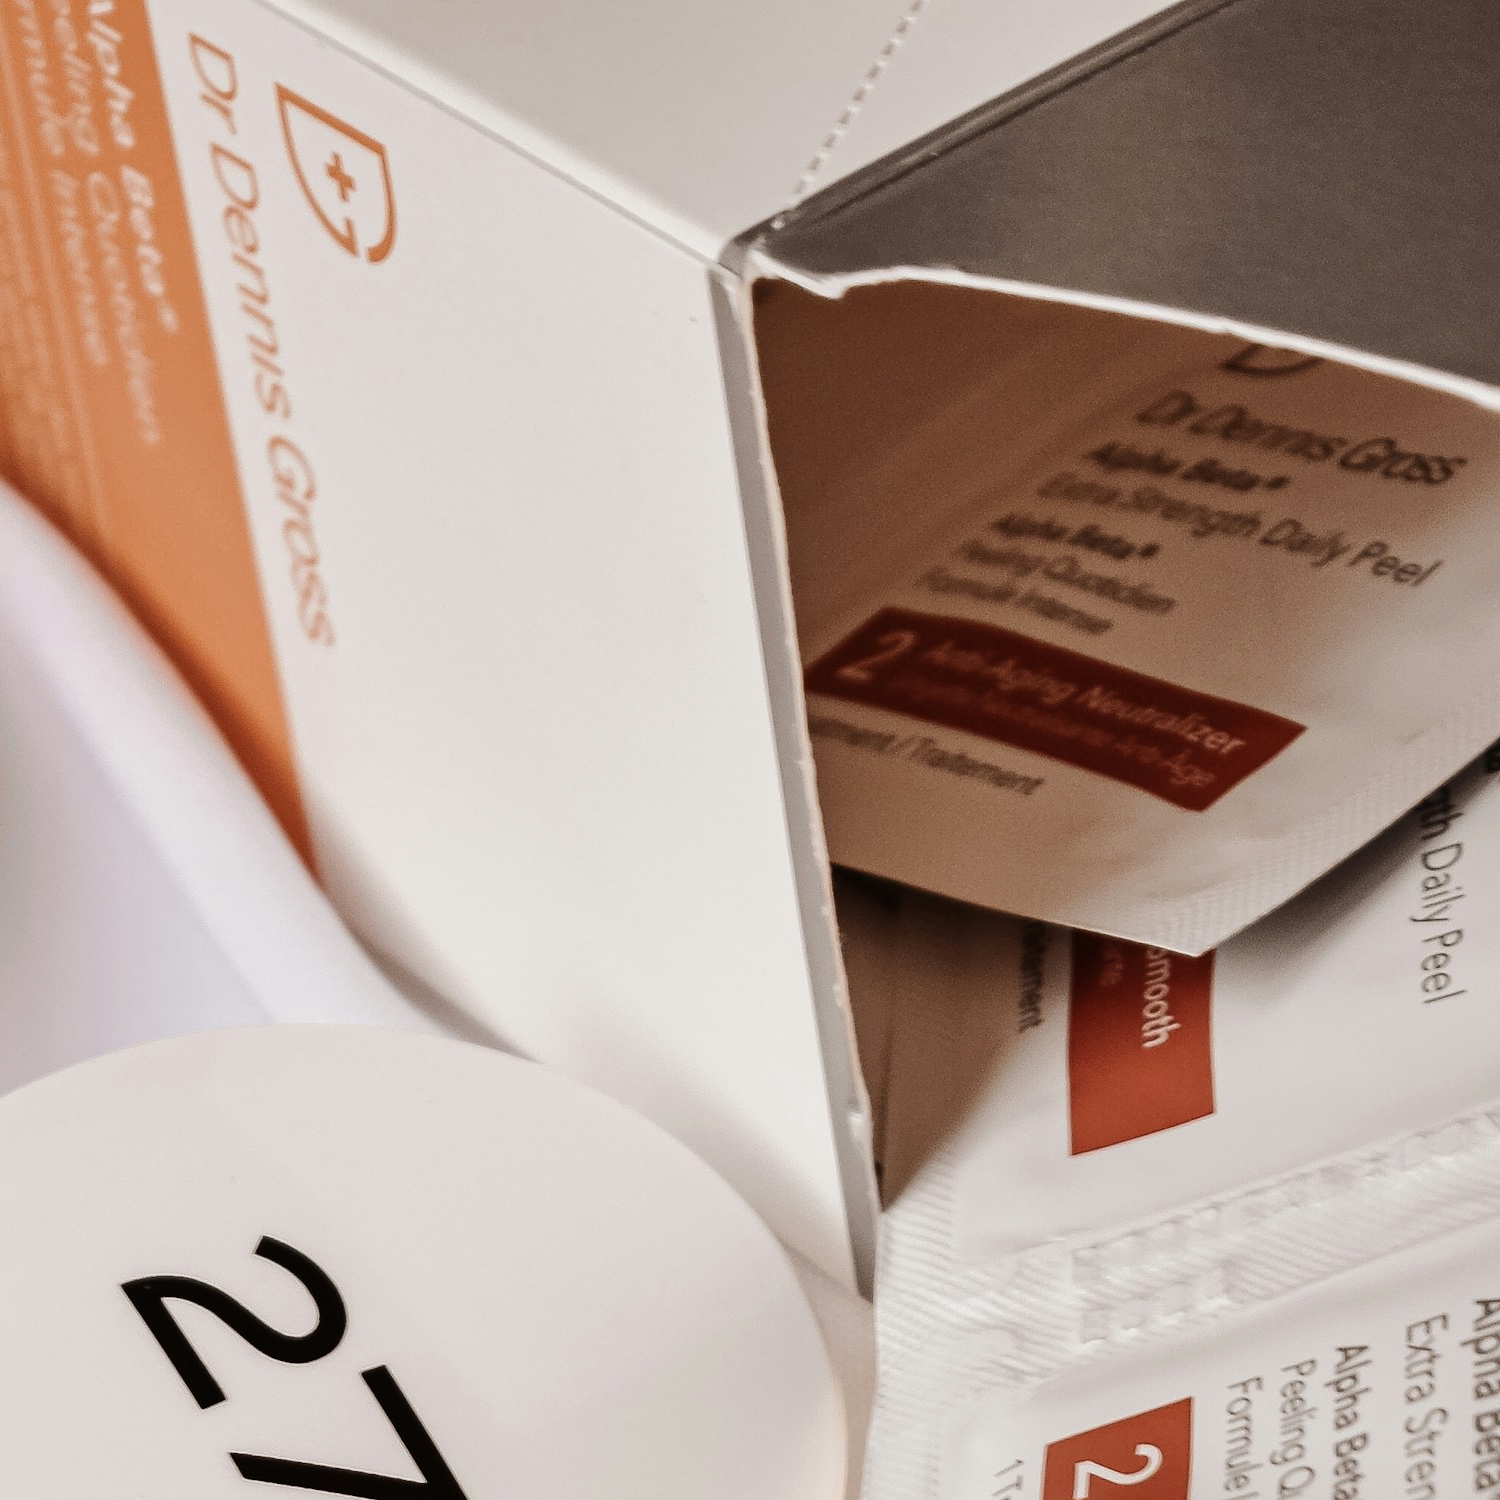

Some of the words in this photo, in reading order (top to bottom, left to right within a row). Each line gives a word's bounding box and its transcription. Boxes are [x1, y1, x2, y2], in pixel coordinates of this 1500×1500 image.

[189, 31, 239, 134] Dr
[208, 141, 293, 421] Dennis
[1338, 436, 1467, 485] Gross
[266, 432, 336, 649] Gross
[1260, 518, 1350, 568] Daily
[1350, 541, 1445, 587] Peel
[1411, 841, 1466, 923] Daily
[1420, 929, 1467, 1004] Peel
[1323, 1344, 1372, 1431] Alpha
[1405, 1313, 1449, 1403] Extra
[1224, 1376, 1264, 1491] Formule
[1270, 1359, 1318, 1467] Peeling
[1072, 1443, 1164, 1500] 2
